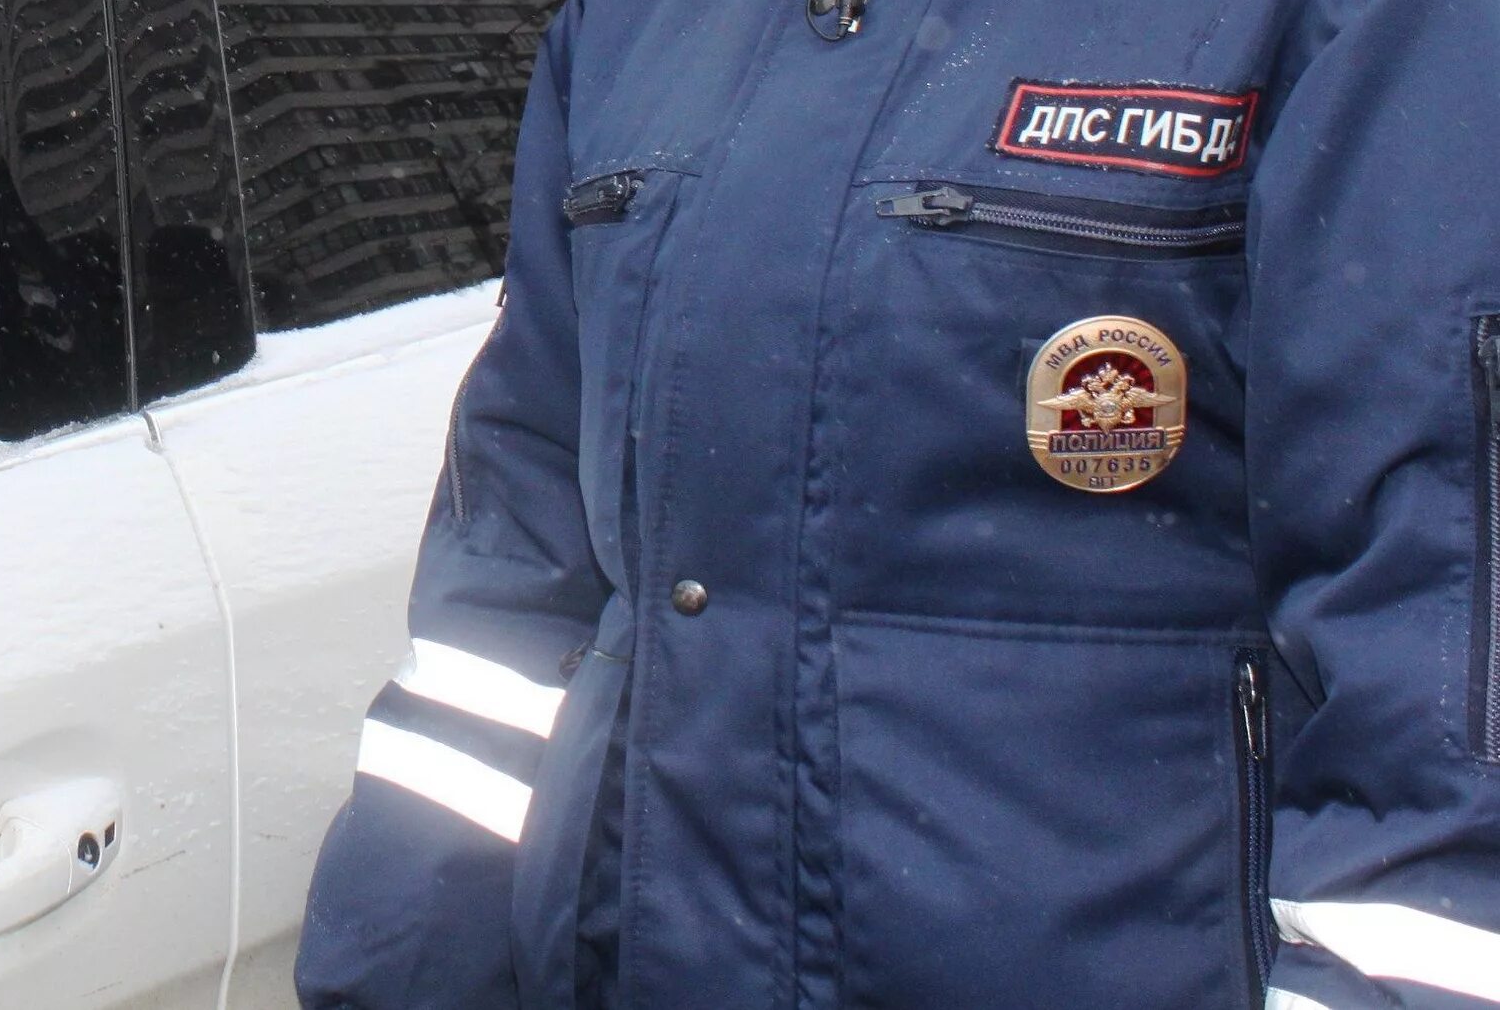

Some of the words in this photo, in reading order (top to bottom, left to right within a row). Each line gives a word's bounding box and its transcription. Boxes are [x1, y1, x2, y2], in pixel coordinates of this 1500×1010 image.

[1018, 105, 1111, 145] ДПС
[1045, 334, 1090, 370] МВД
[1098, 328, 1172, 368] РОССИИ
[1052, 431, 1161, 451] ПОЛИЦИЯ
